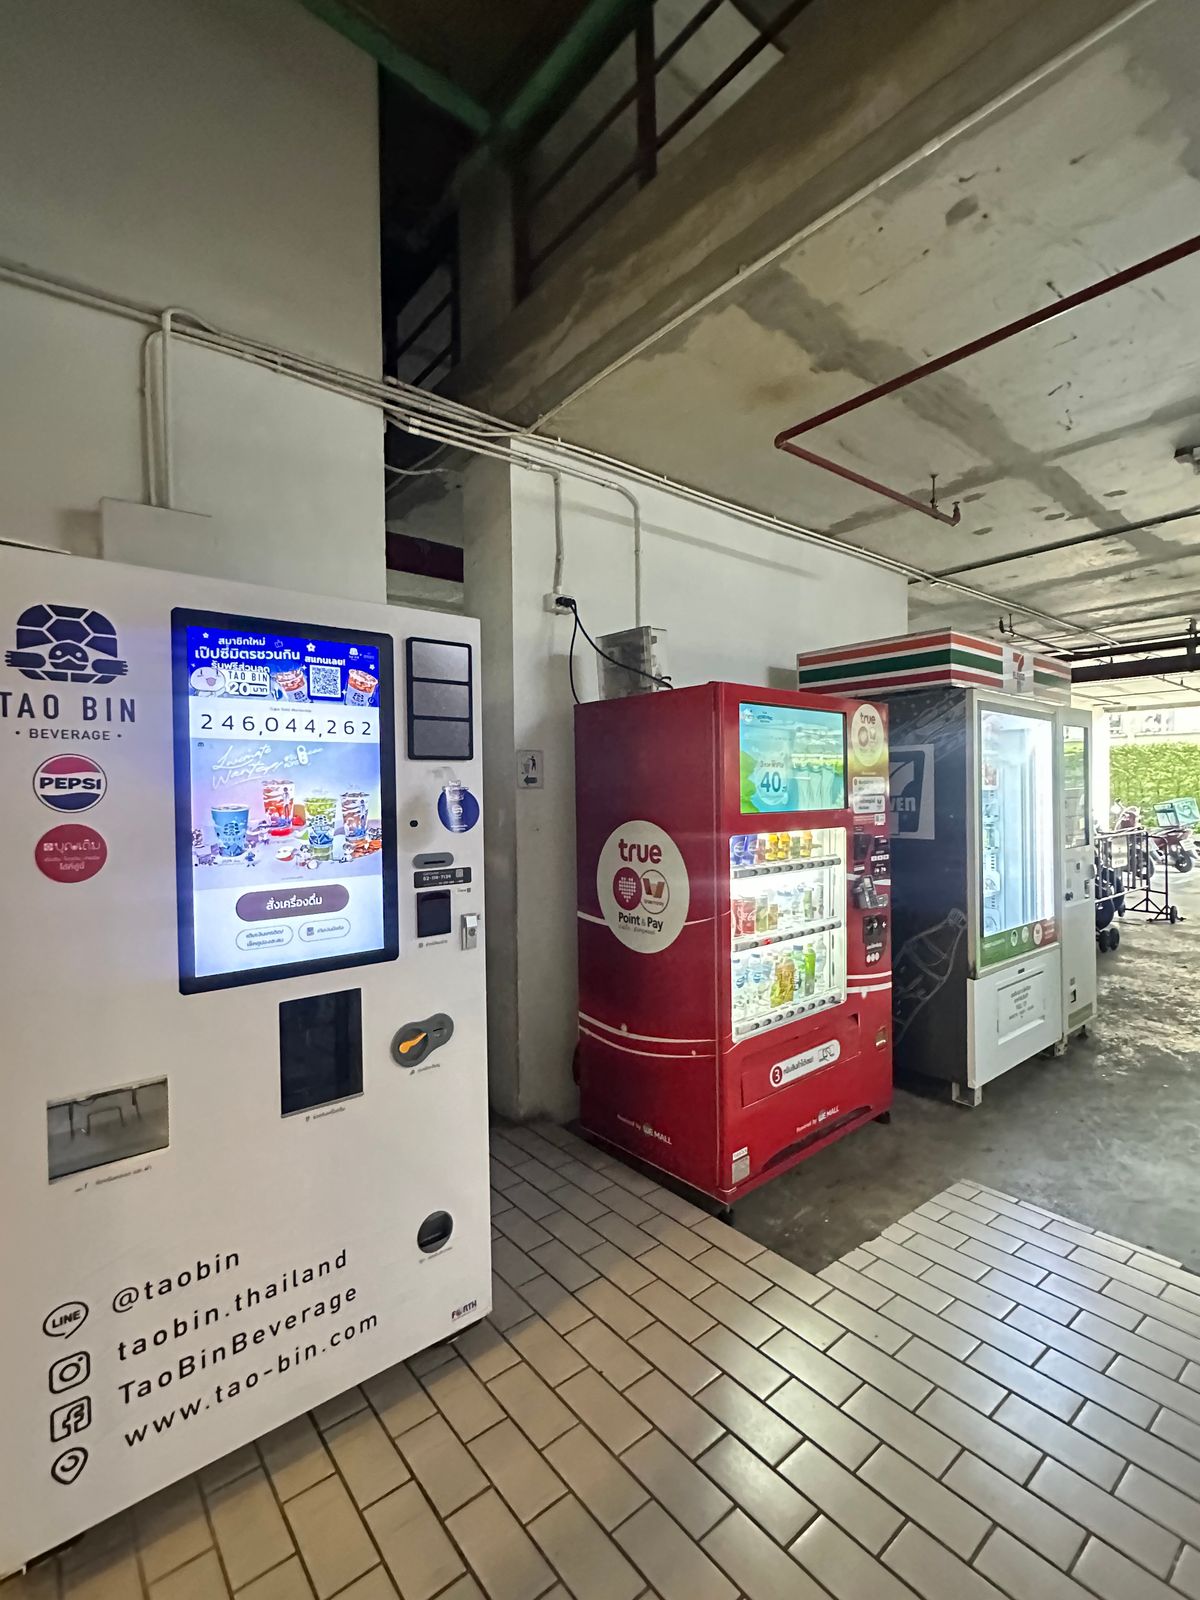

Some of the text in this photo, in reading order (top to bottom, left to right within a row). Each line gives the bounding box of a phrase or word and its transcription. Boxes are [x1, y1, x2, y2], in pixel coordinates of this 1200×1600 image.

[217, 636, 266, 647] สมาชิกใหม่
[228, 671, 268, 682] TAO BIN
[0, 692, 136, 723] TAO BIN
[860, 712, 876, 725] true
[29, 728, 111, 742] BEVERAGE
[201, 713, 371, 738] 246,044,262
[39, 777, 101, 790] PEPSI
[760, 771, 781, 793] 40
[618, 838, 662, 864] true
[266, 895, 323, 911] สั่งเครื่องดื่ม
[618, 911, 641, 926] Point
[647, 916, 664, 933] Pay
[774, 1068, 781, 1082] 3
[112, 1251, 240, 1314] @taobin
[117, 1248, 348, 1361] taobin.thailand
[51, 1309, 82, 1329] LINE
[117, 1286, 358, 1404] TaoBinBeverage
[124, 1314, 378, 1448] www.tao-bin.com
